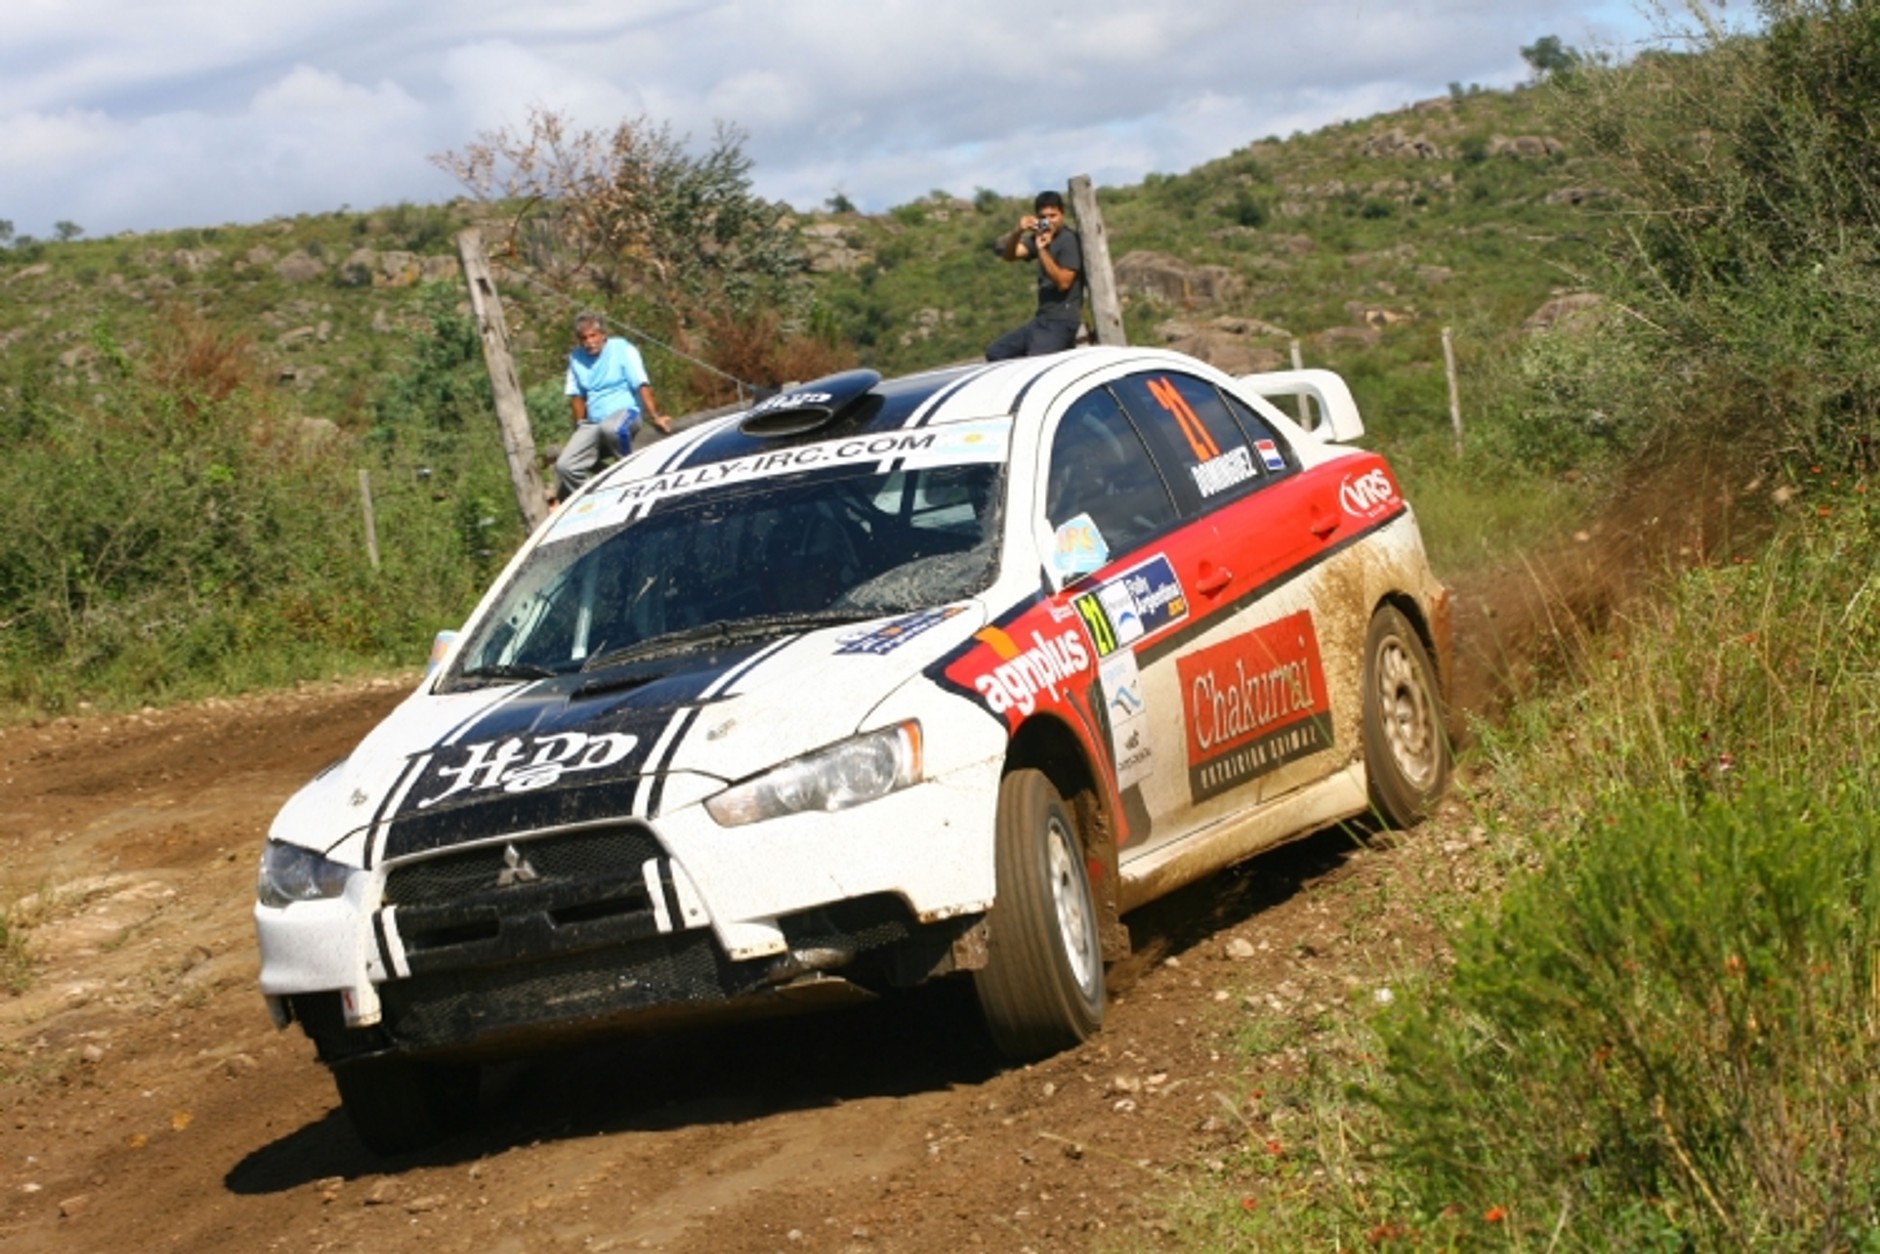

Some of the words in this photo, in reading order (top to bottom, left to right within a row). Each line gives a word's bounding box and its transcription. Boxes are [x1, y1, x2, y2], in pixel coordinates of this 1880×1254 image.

[1146, 376, 1221, 464] 21
[617, 433, 936, 504] RALLY-IRC.COM
[1344, 468, 1392, 510] VRS
[1077, 592, 1117, 657] 21
